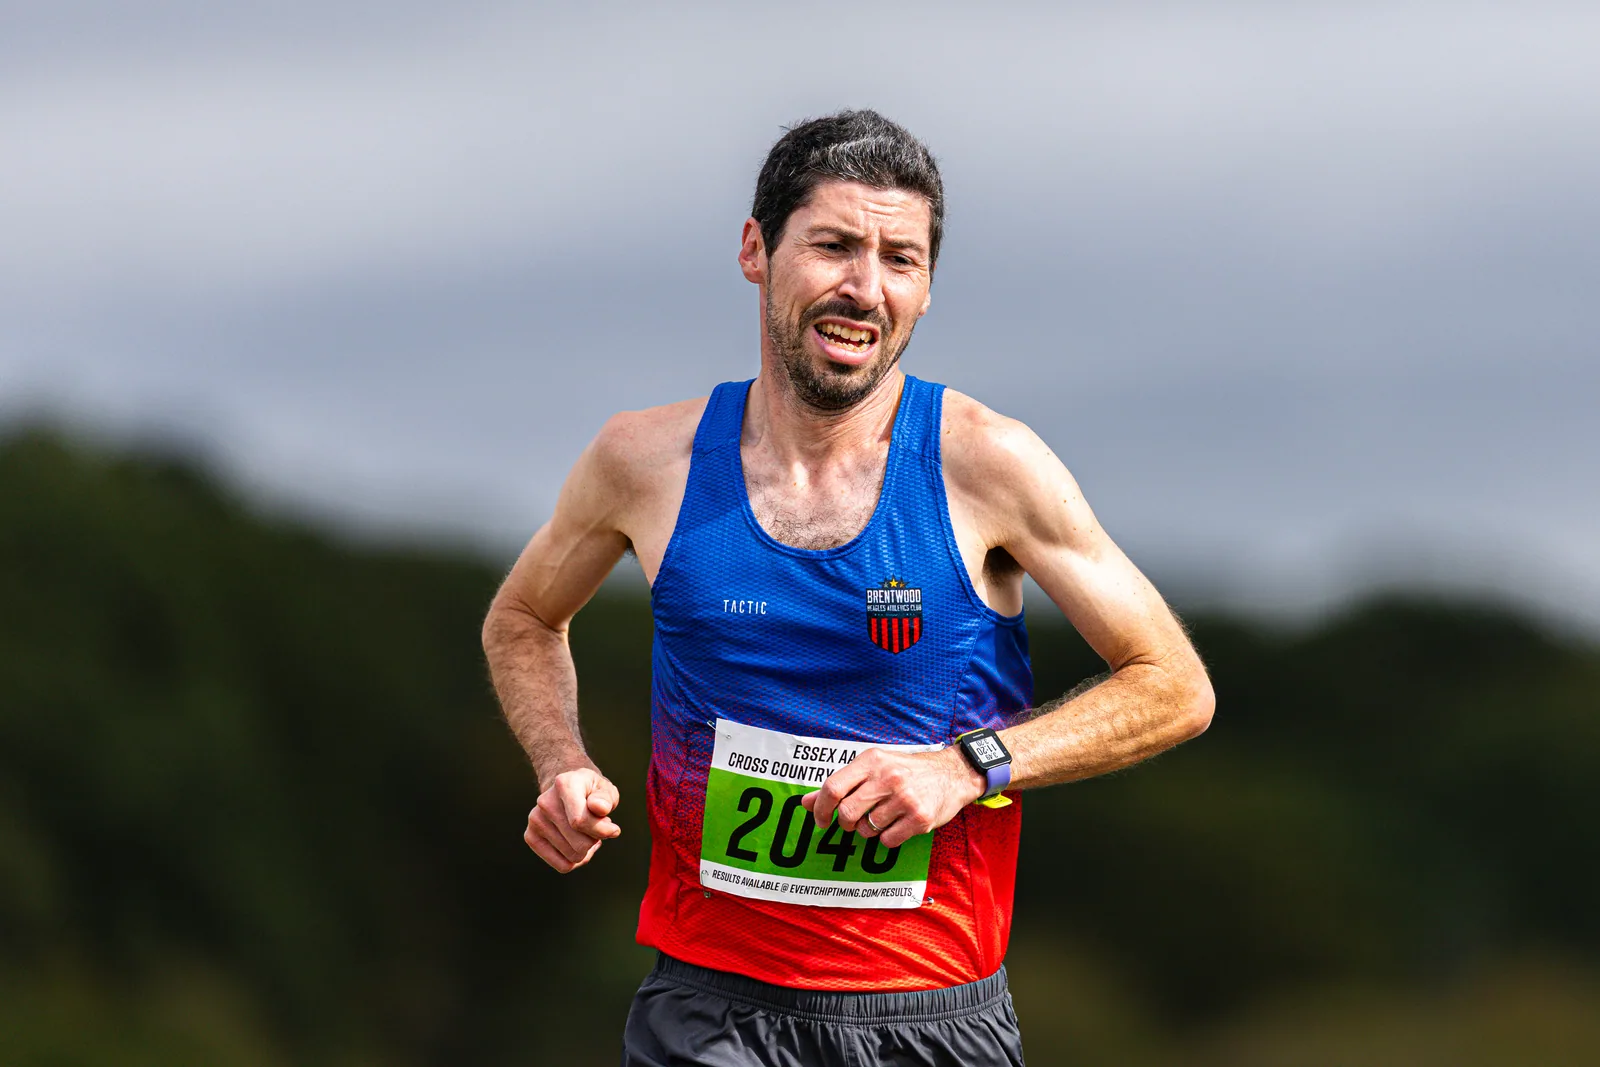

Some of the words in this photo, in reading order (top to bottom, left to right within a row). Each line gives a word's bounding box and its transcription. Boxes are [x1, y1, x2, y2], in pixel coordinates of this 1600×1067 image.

[866, 589, 921, 603] BRENTWOOD
[723, 599, 767, 615] TACTIC
[867, 604, 886, 612] BEAGLES
[887, 604, 910, 612] ATHLETICS
[793, 744, 838, 764] ESSEX
[728, 752, 769, 774] CROSS
[771, 761, 835, 783] COUNTRY
[712, 869, 741, 885] RESULTS
[741, 876, 780, 892] AVAILABLE
[780, 883, 790, 893] @
[789, 884, 913, 898] EVENTCHIPTIMING.COM/RESULTS
